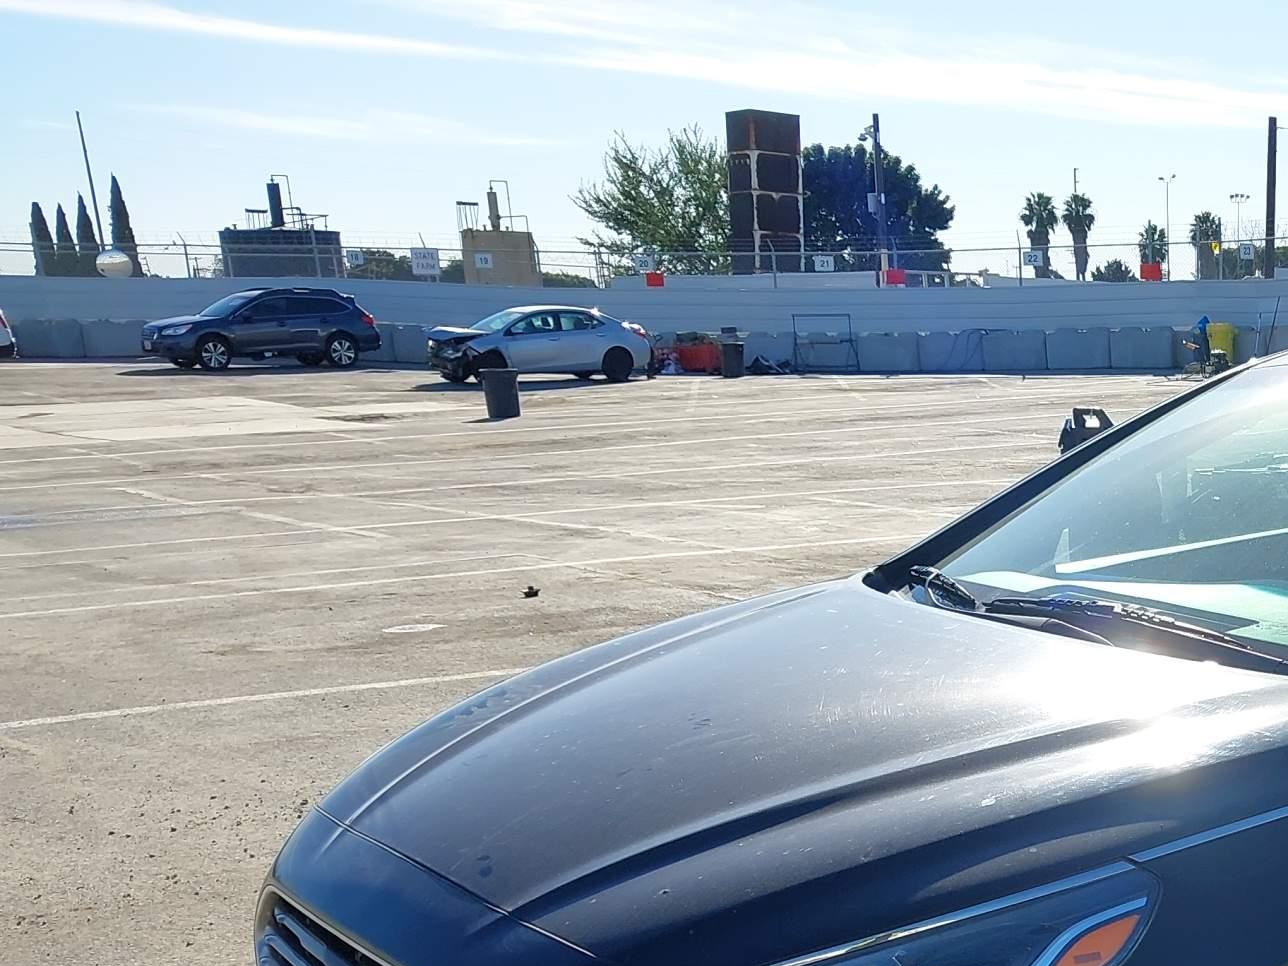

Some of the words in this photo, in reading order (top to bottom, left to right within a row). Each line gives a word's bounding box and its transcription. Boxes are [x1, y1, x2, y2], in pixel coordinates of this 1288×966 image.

[1243, 246, 1251, 256] 23
[413, 252, 435, 260] STATE
[479, 256, 489, 265] 19
[1027, 254, 1039, 263] 22
[415, 262, 436, 271] FARM
[639, 259, 649, 268] 20
[820, 259, 830, 268] 21
